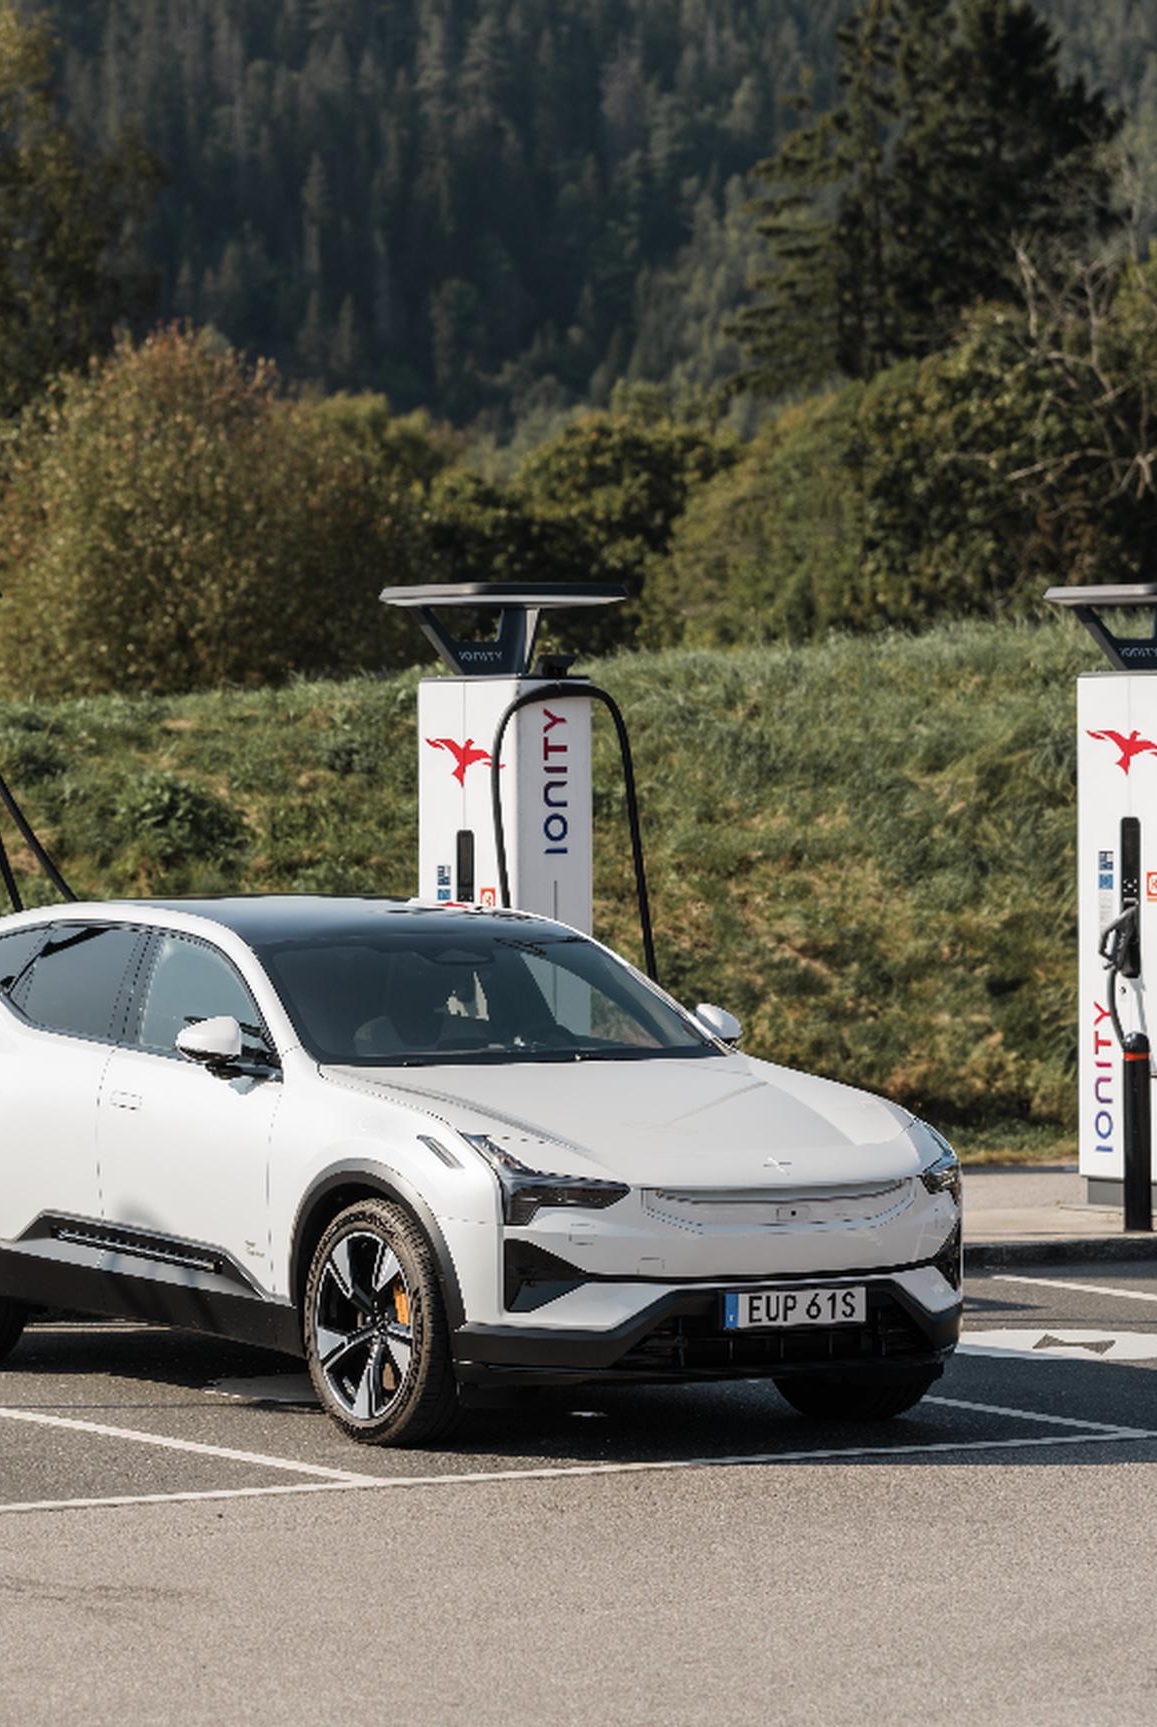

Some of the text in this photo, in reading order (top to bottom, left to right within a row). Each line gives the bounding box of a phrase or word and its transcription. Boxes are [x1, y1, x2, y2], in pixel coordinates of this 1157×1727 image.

[543, 708, 569, 855] IONITY
[1093, 1000, 1114, 1153] IONITY
[748, 1291, 857, 1323] EUP 61S
